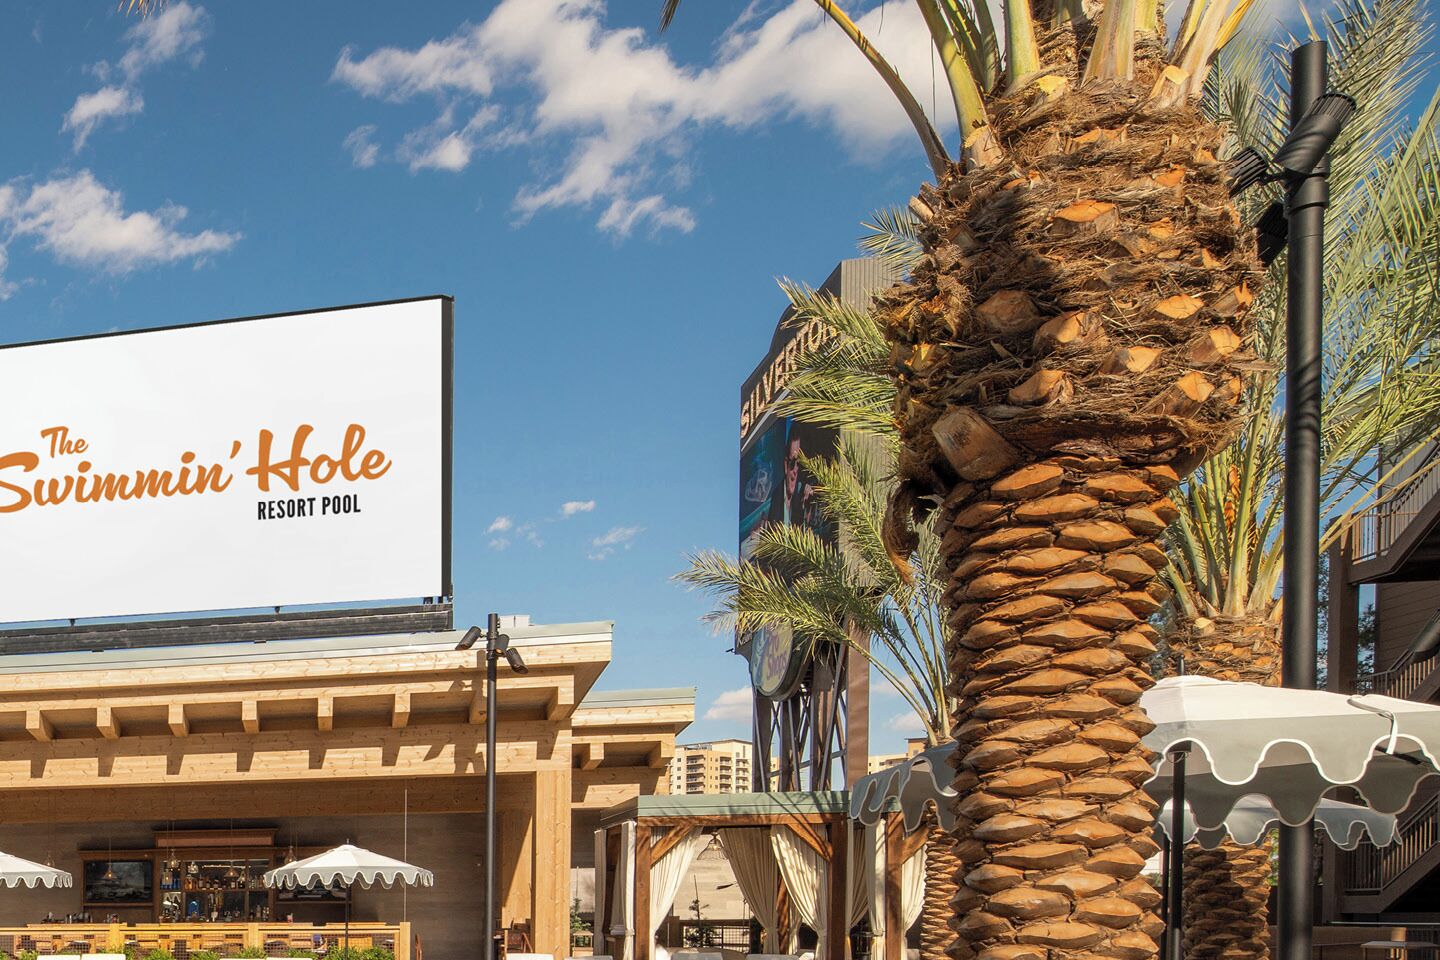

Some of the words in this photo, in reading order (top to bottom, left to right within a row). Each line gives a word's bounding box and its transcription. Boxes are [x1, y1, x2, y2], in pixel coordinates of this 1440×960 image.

[40, 426, 88, 458] The
[245, 423, 392, 492] Hole
[257, 497, 316, 521] RESORT
[322, 494, 361, 516] POOL
